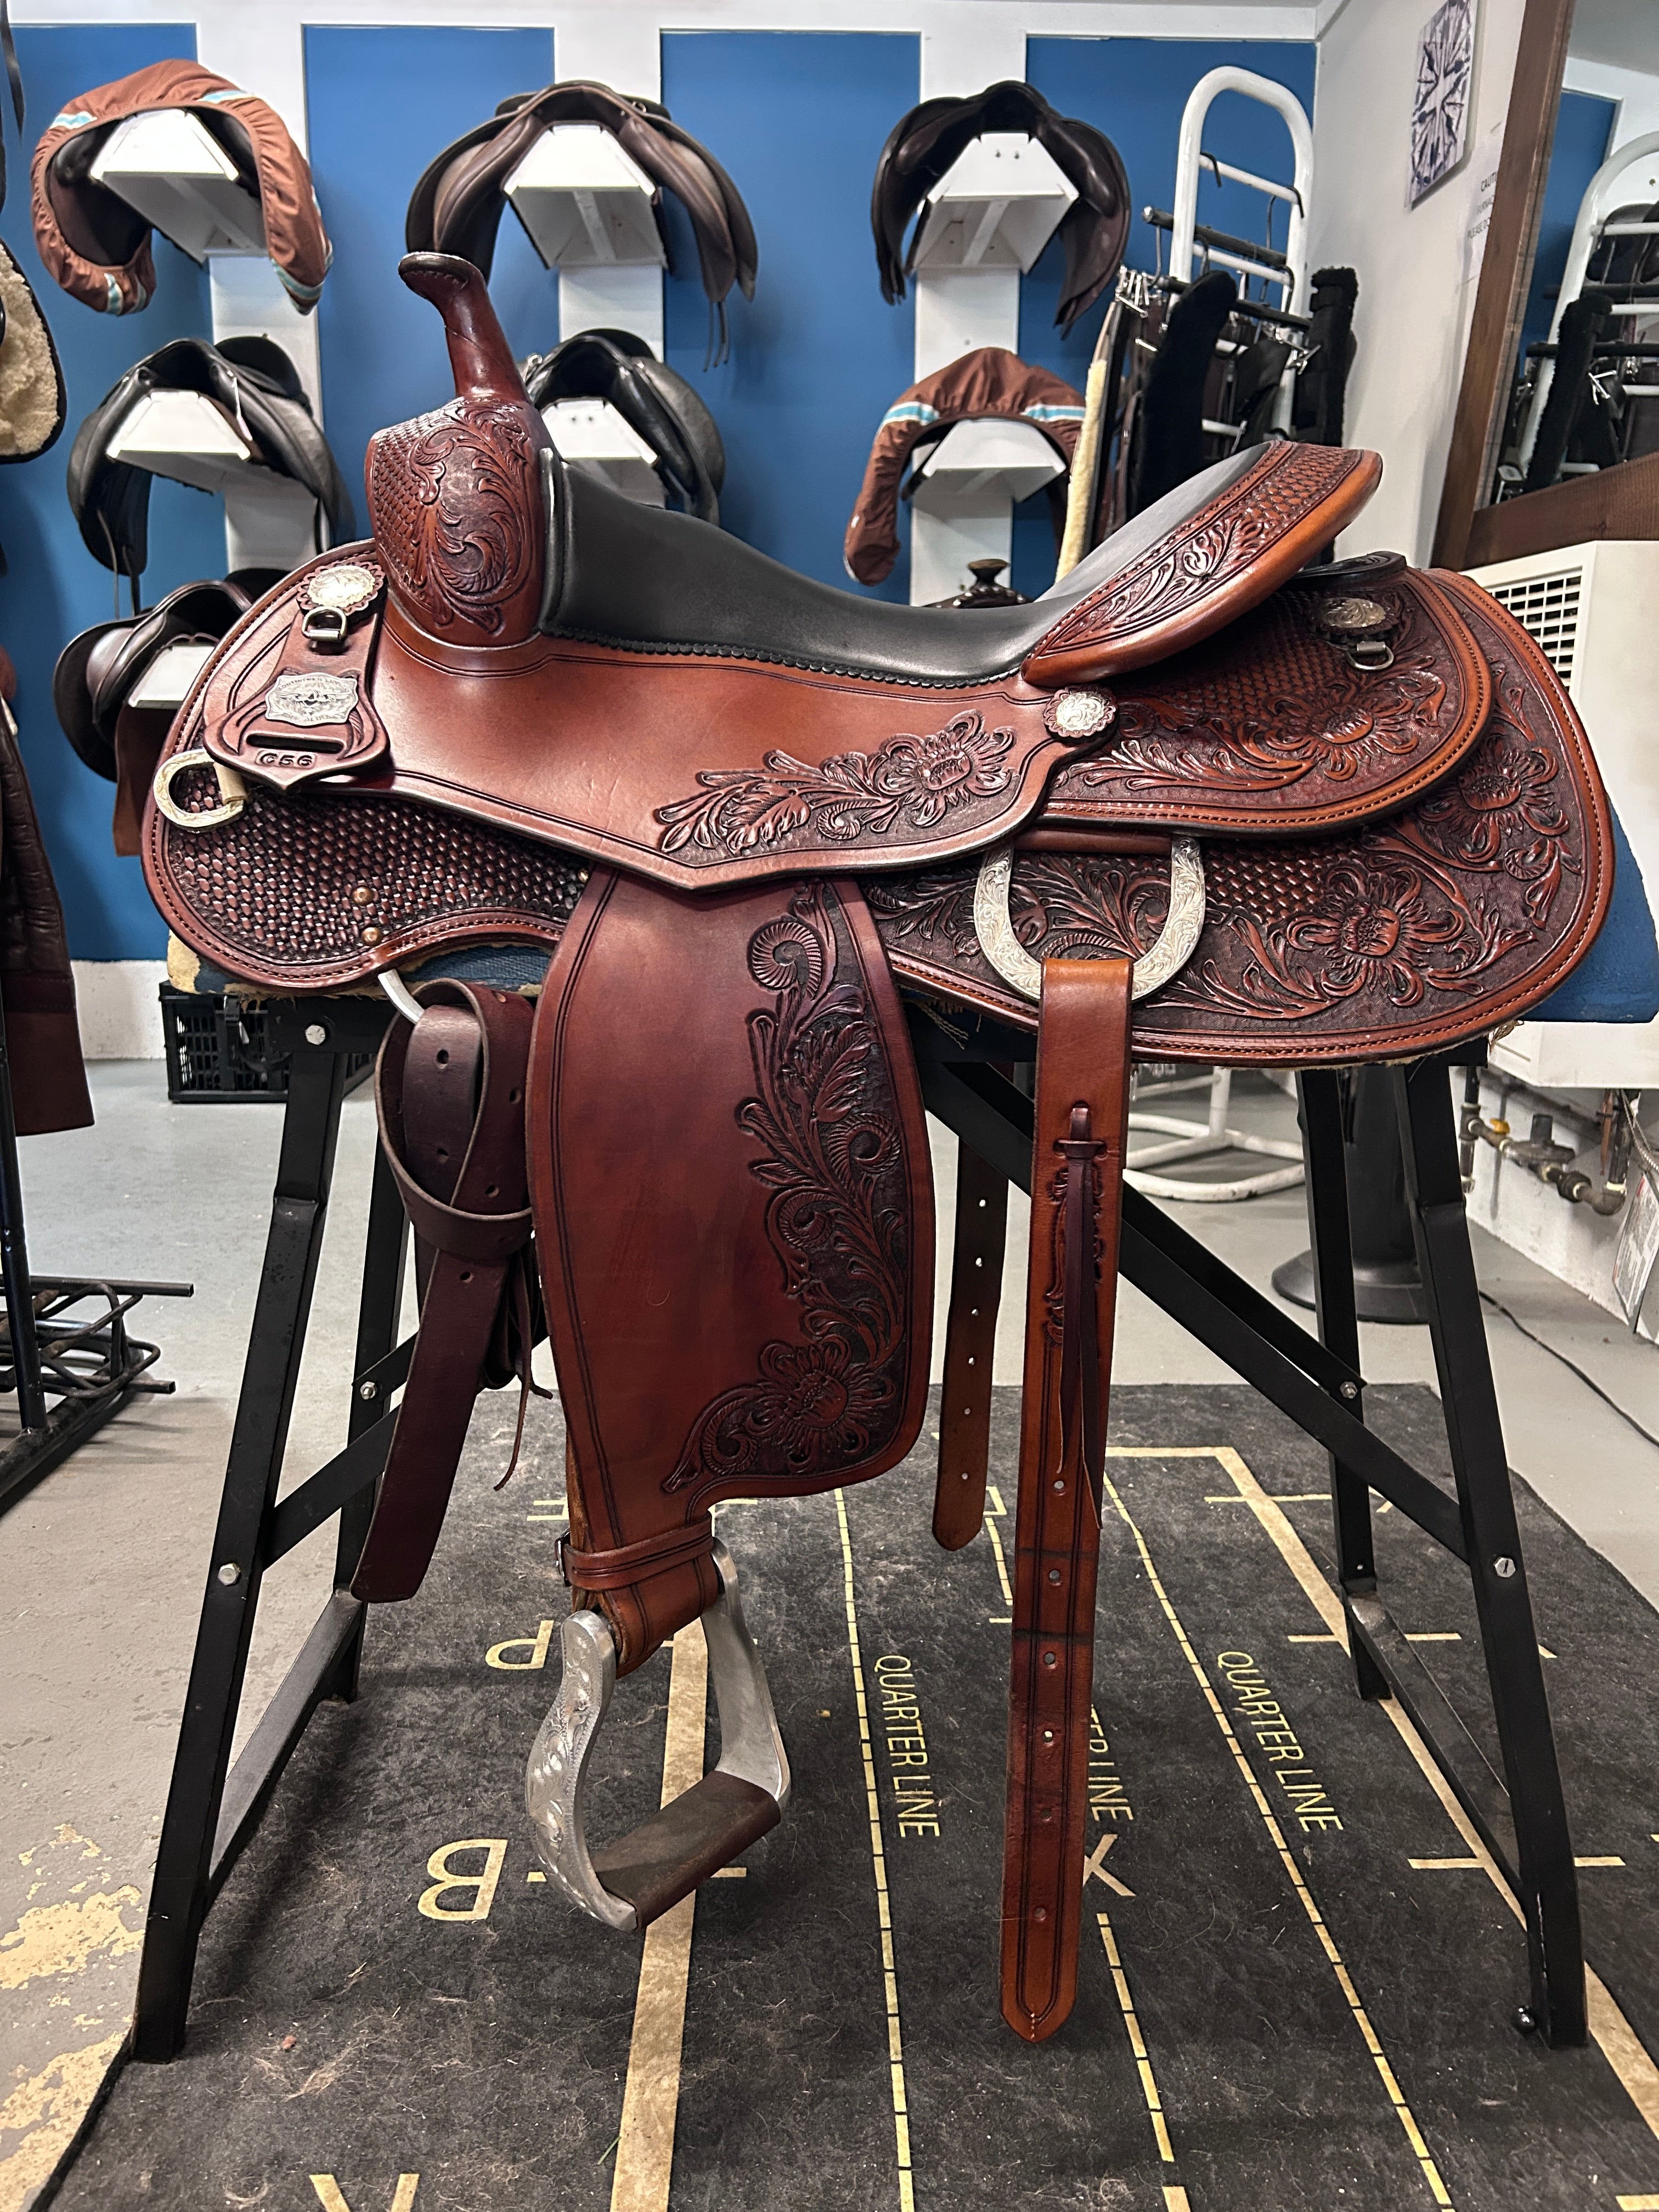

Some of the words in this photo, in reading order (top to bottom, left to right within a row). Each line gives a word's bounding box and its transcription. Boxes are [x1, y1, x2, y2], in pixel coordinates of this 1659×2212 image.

[486, 1620, 554, 1670] P
[874, 1655, 928, 1767] QUARTER
[1217, 1651, 1304, 1762] QUARTER
[1276, 1769, 1344, 1832] LINE
[893, 1775, 940, 1837] LINE
[417, 1838, 508, 1921] B
